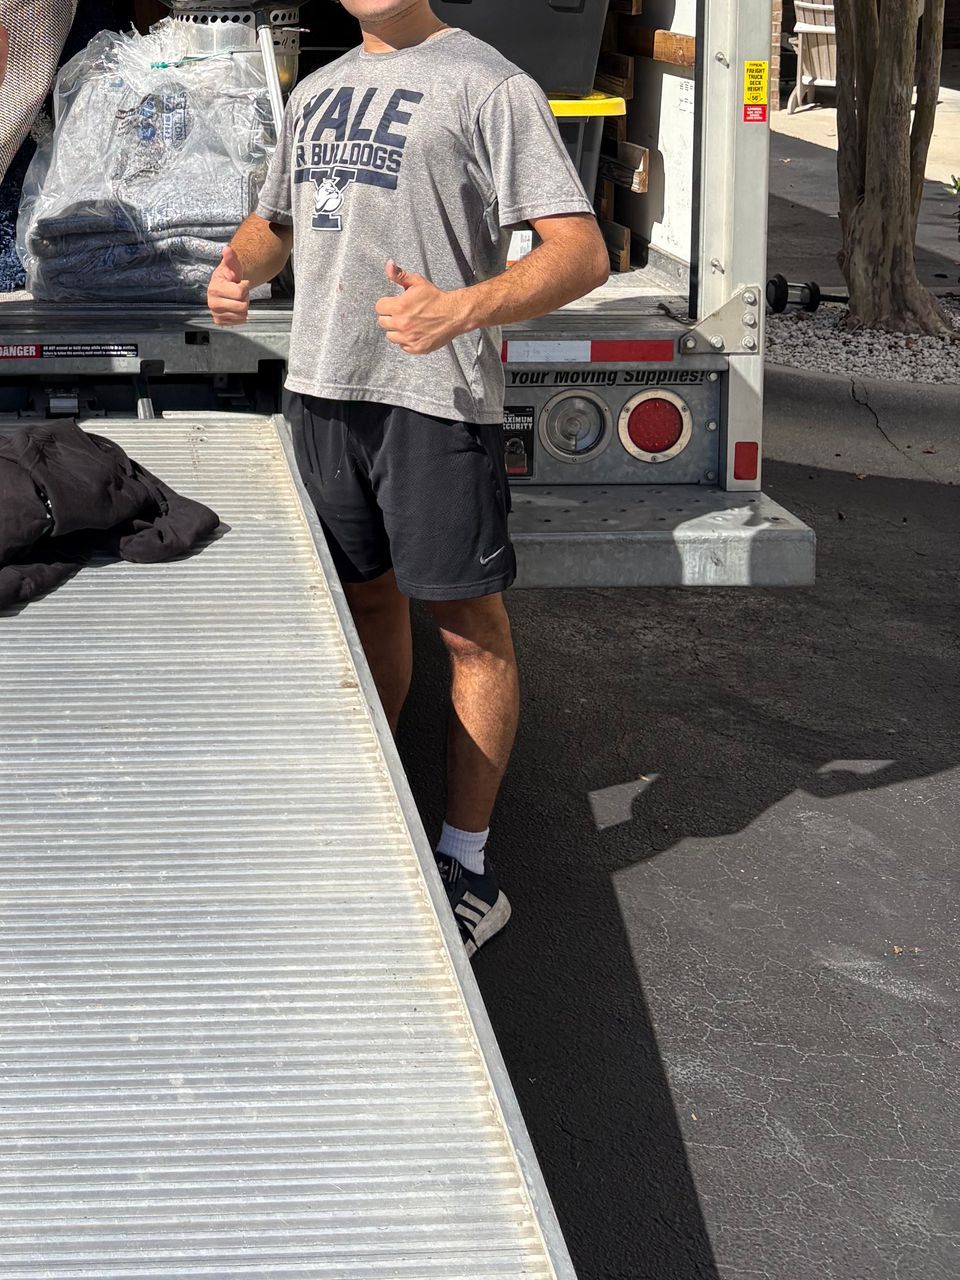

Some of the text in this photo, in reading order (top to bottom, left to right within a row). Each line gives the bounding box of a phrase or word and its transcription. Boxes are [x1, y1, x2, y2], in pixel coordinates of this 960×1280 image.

[297, 86, 424, 149] YALE
[311, 142, 403, 173] BULLDOGS
[511, 370, 704, 387] Your Moving Supplies!
[503, 422, 533, 430] CURITY
